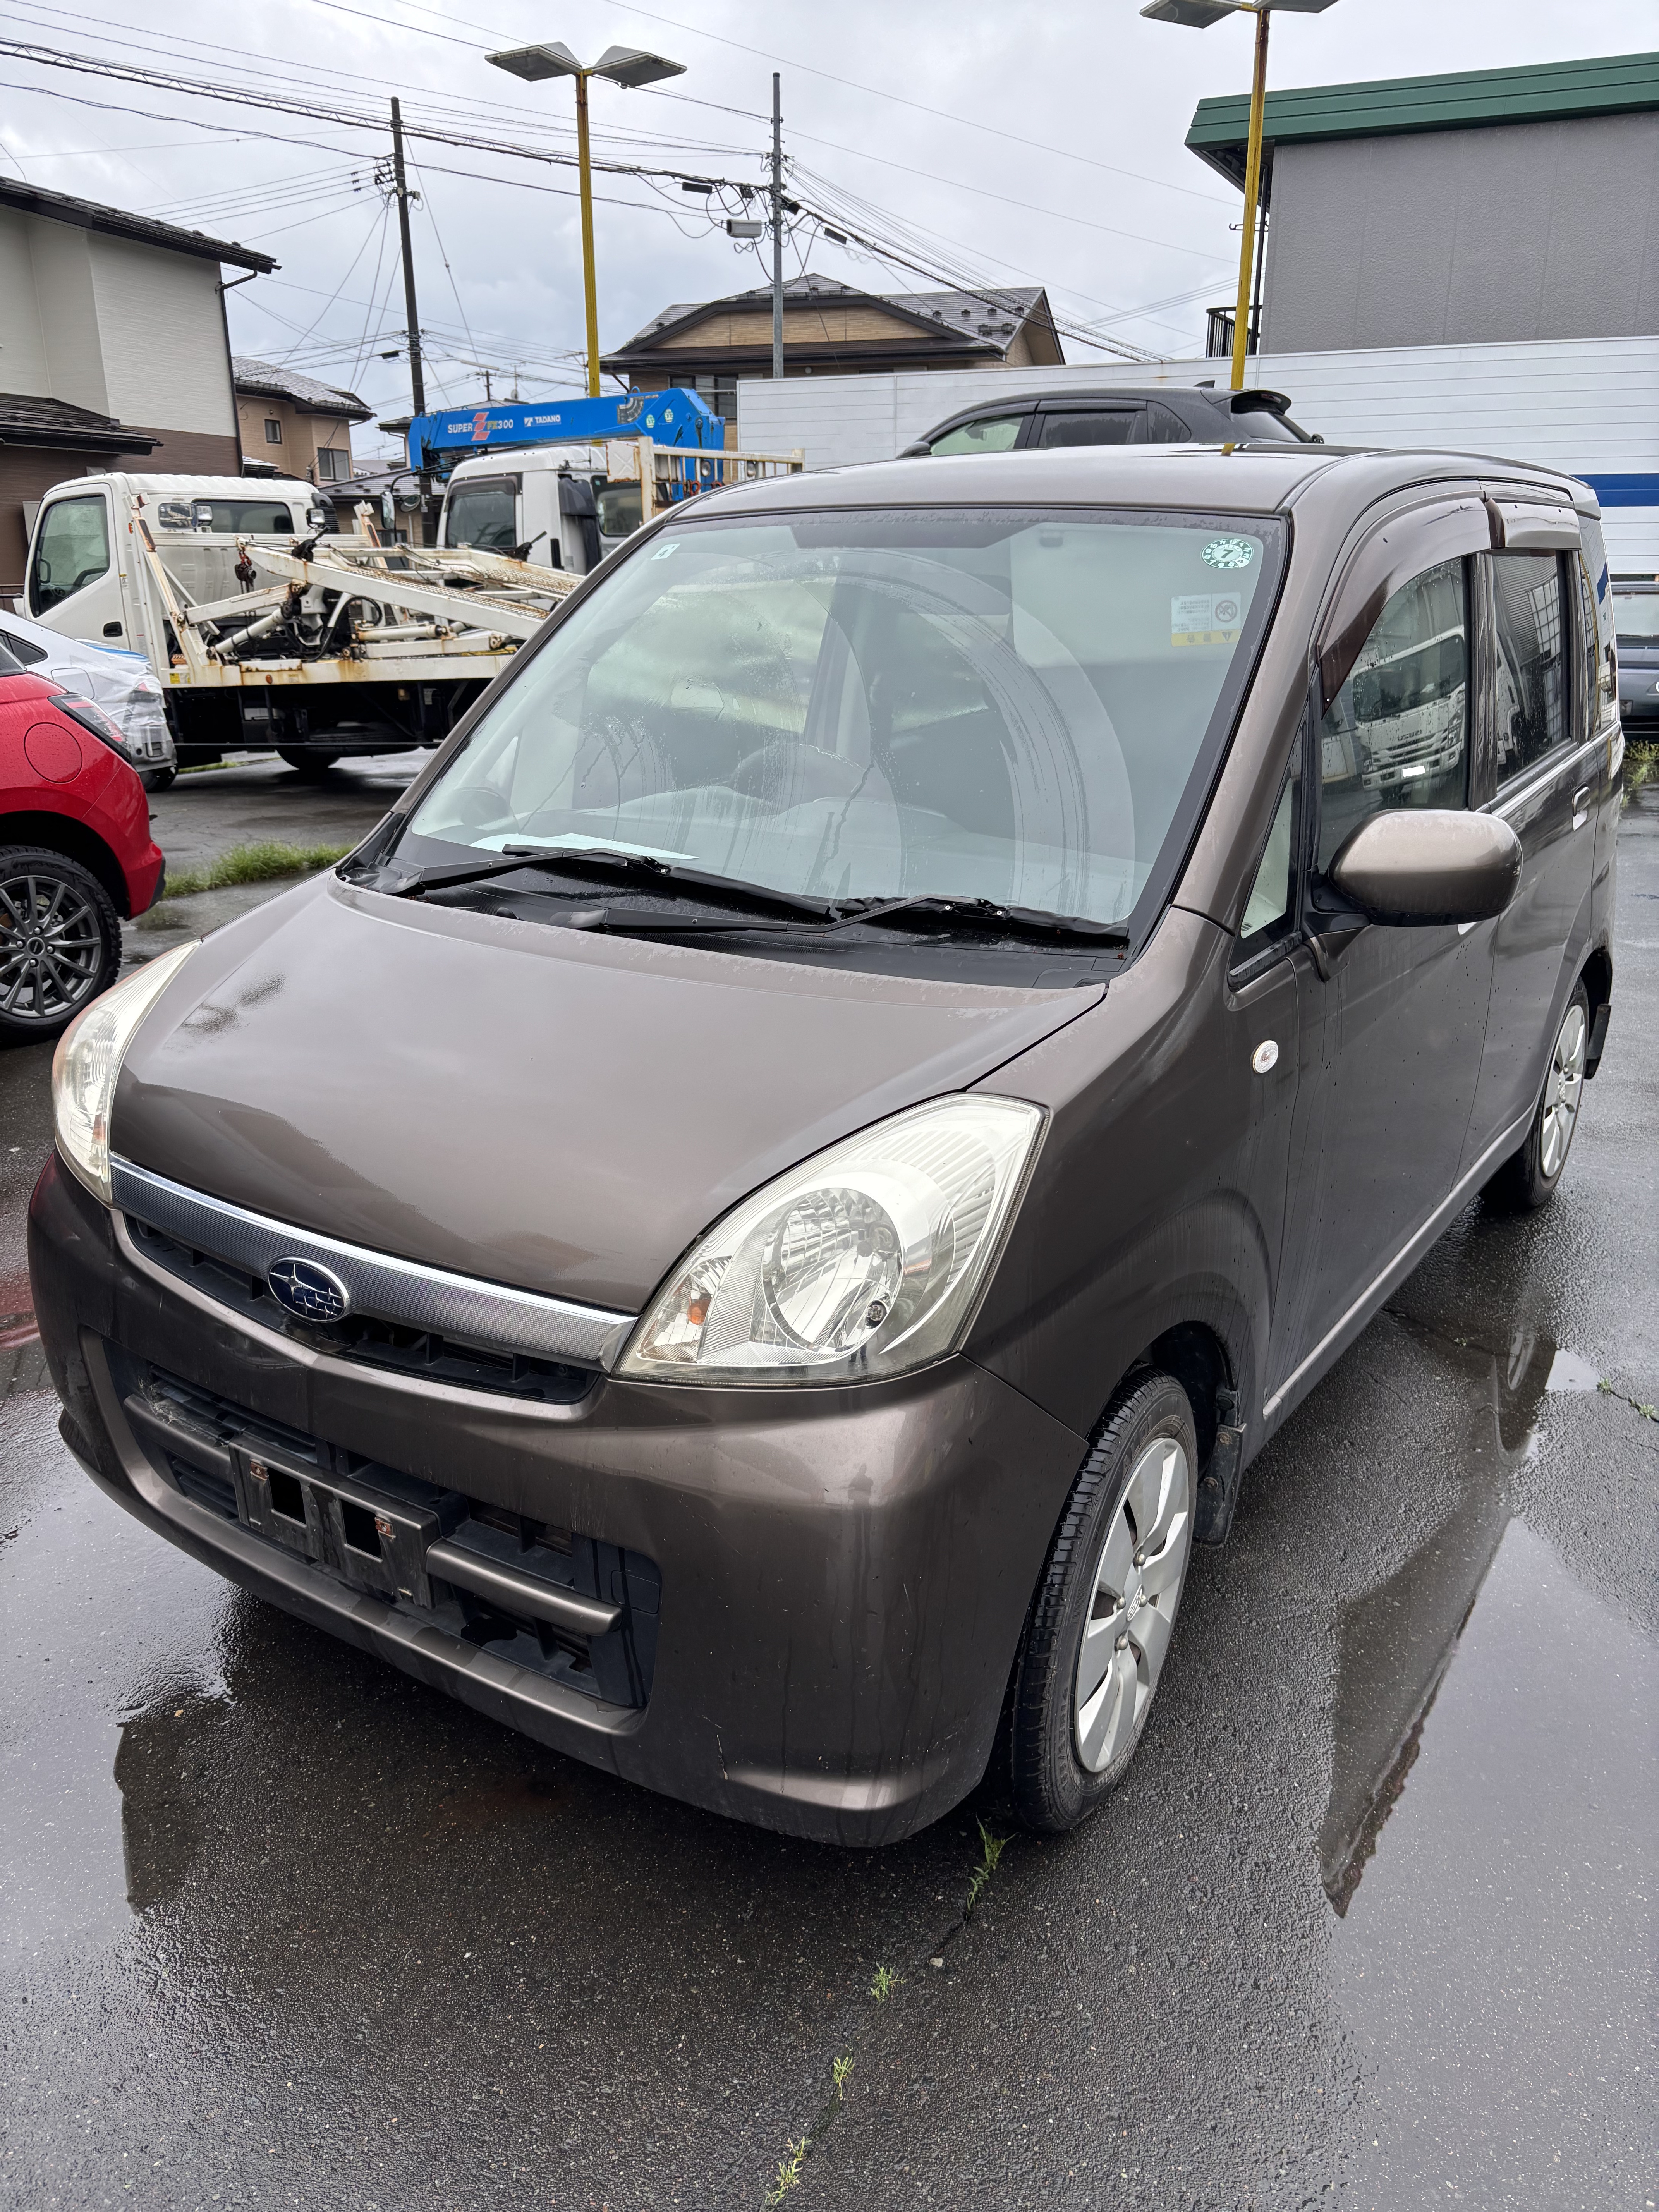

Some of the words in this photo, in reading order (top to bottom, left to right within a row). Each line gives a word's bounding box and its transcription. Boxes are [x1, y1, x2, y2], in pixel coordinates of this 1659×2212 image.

[534, 414, 561, 424] TADANO
[448, 423, 473, 433] SUPER
[487, 419, 514, 430] FX300
[1221, 549, 1234, 559] 7
